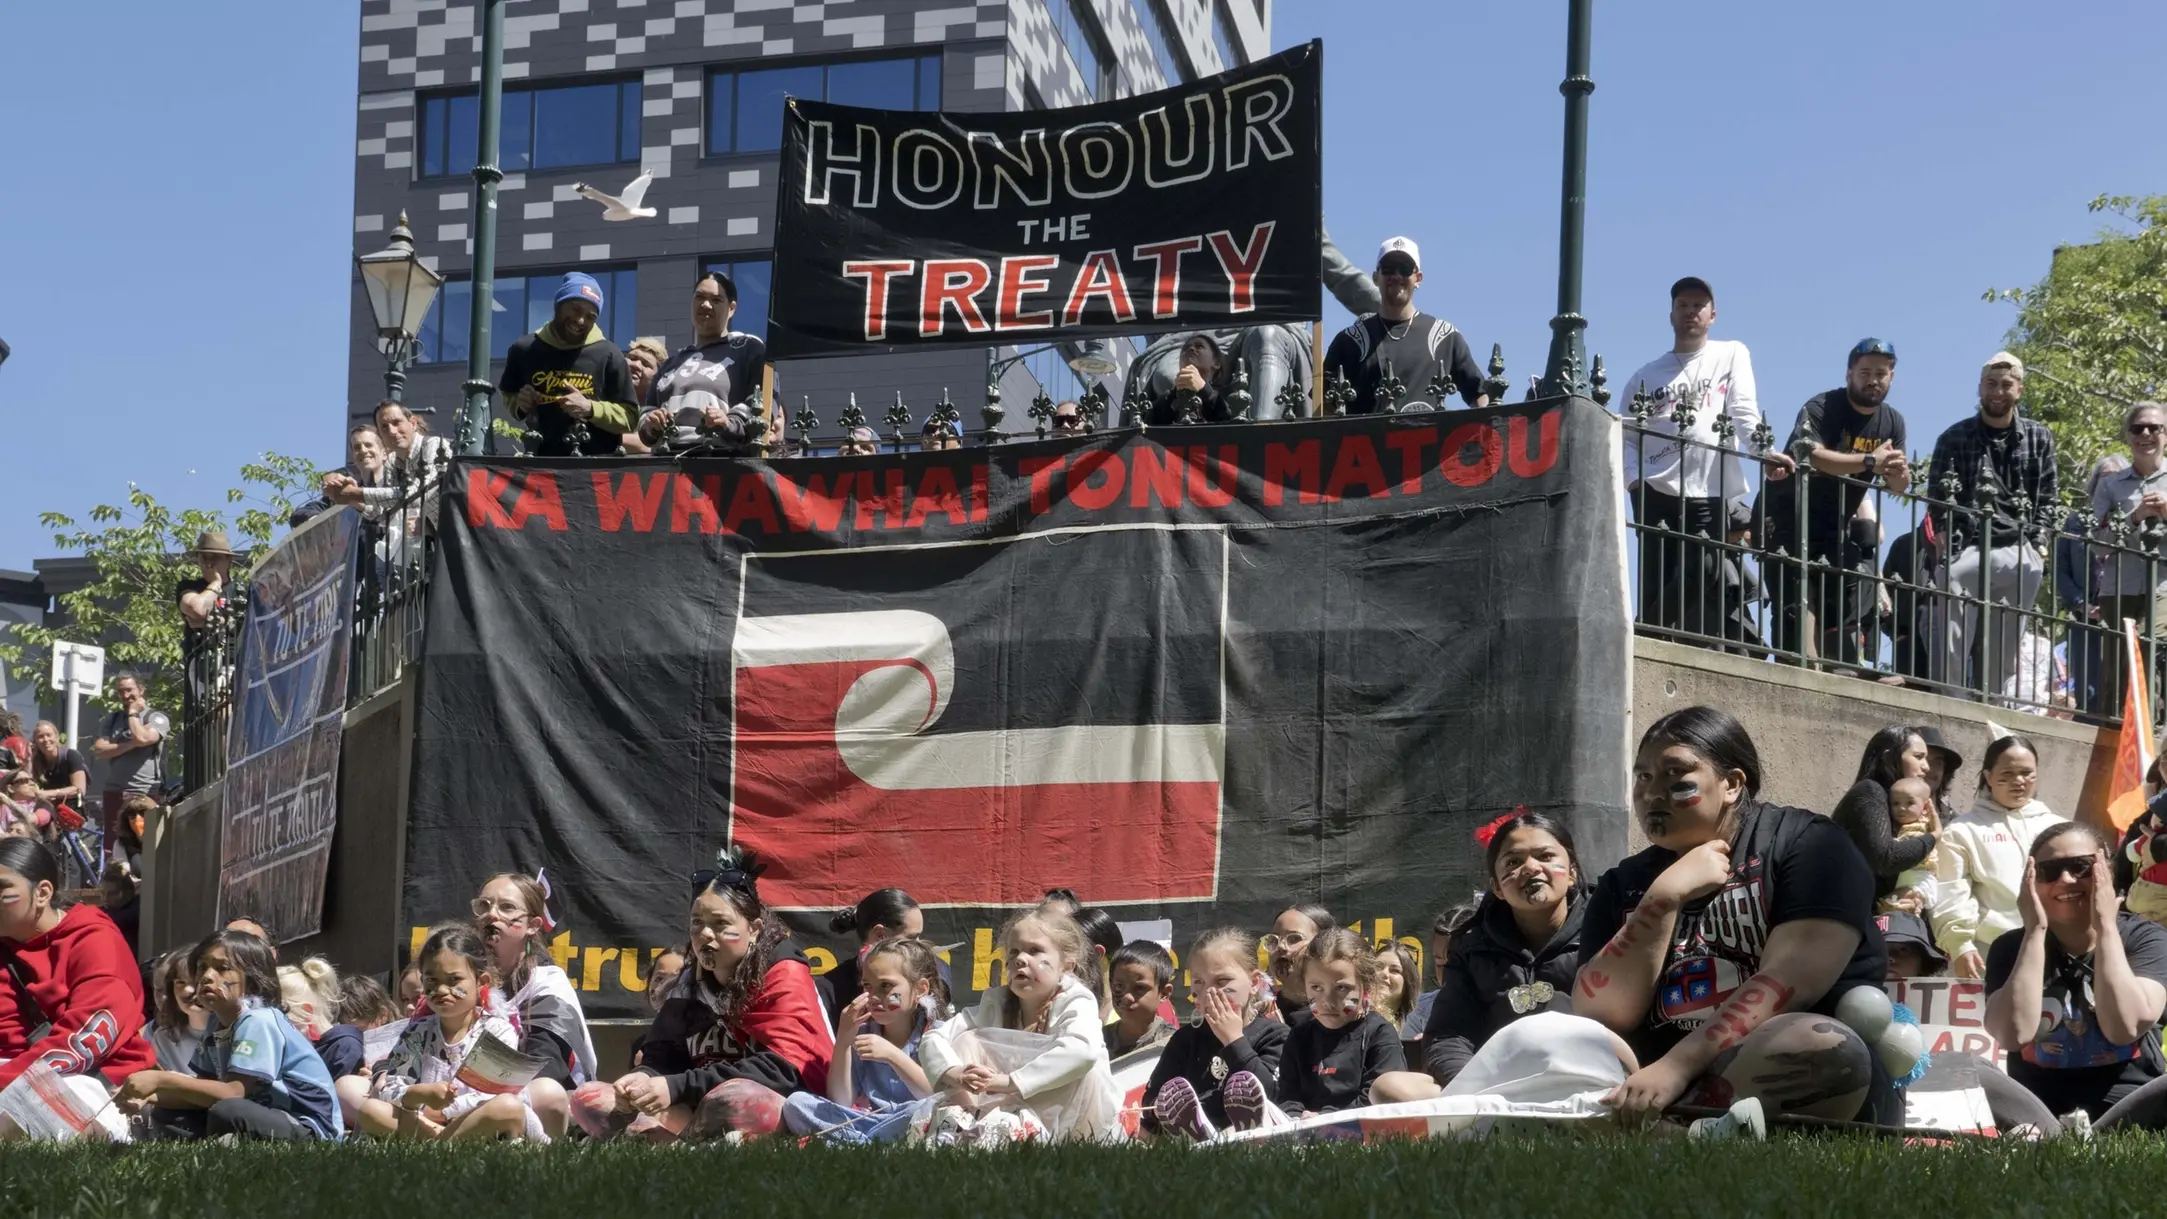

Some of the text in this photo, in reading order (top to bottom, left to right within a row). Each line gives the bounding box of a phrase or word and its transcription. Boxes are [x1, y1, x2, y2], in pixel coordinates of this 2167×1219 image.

[805, 73, 1295, 210] HONOUR
[842, 220, 1277, 342] TREATY
[1017, 213, 1092, 246] THE
[467, 410, 1560, 535] KA WHAWHAI TONU MATOU
